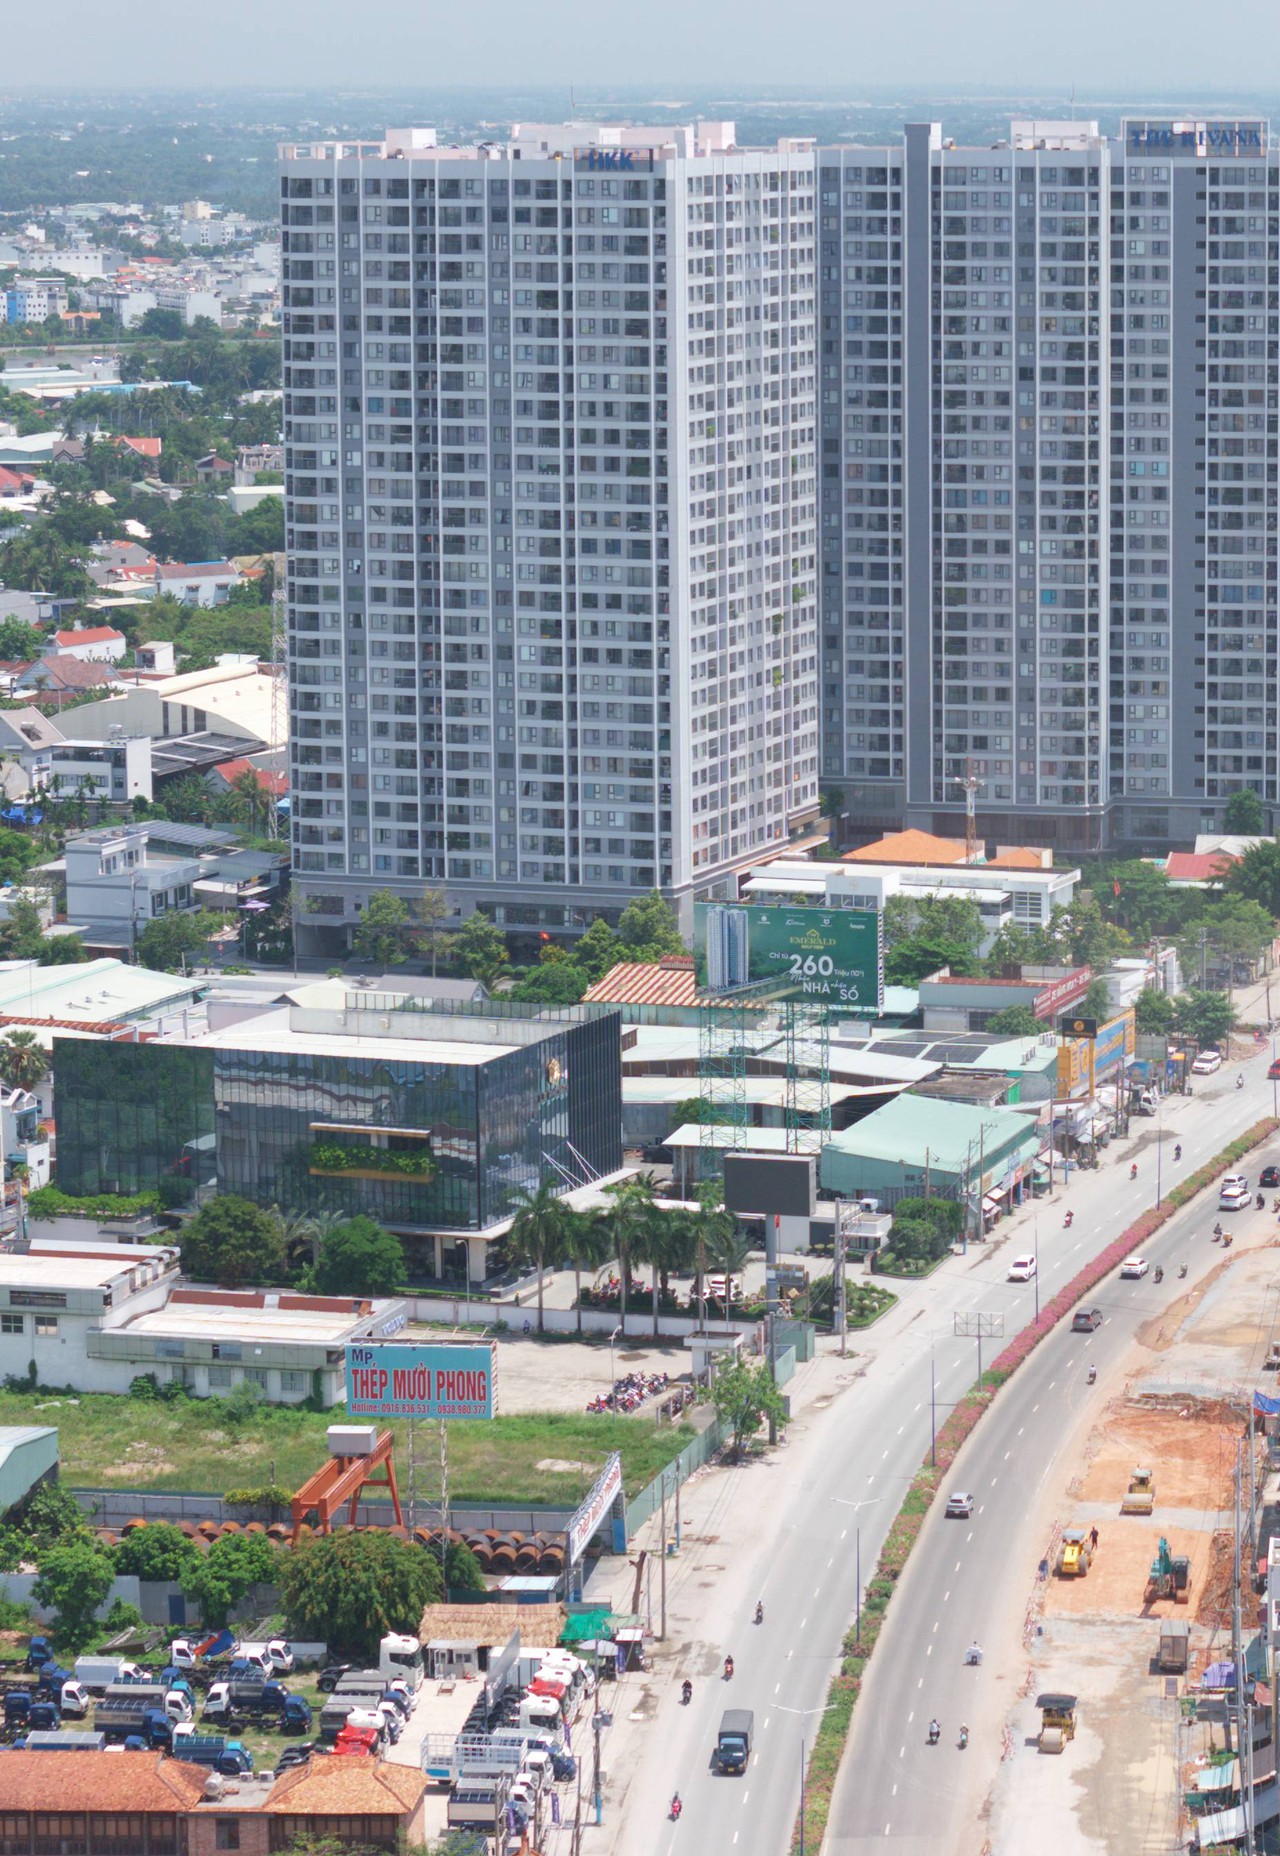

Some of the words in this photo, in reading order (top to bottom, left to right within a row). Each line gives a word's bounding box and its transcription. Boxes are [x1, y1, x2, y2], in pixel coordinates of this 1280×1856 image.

[789, 935, 836, 946] EMERALD
[789, 953, 834, 977] 260
[803, 980, 831, 994] NHÀ
[351, 1362, 389, 1399] THÉP
[393, 1362, 431, 1401] MƯỜI
[436, 1370, 487, 1402] PHONG
[351, 1403, 380, 1413] Hotline:
